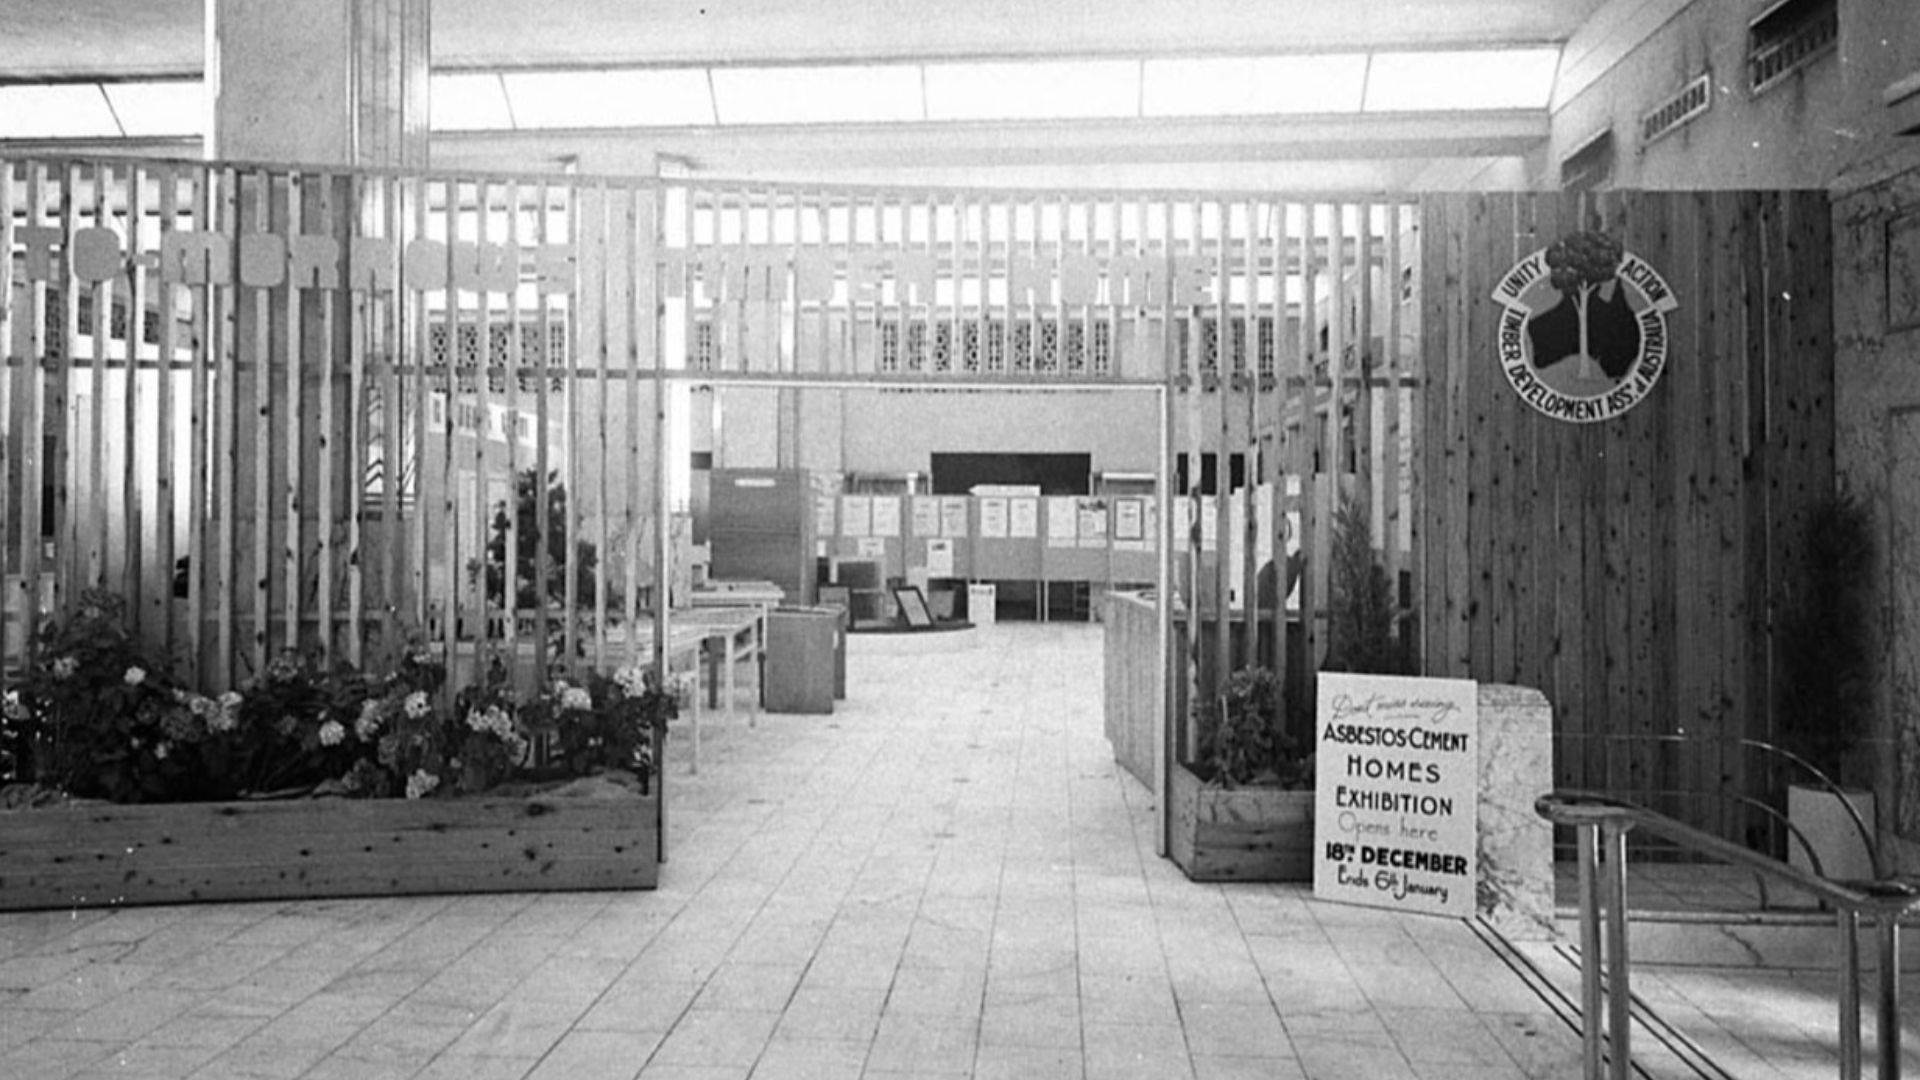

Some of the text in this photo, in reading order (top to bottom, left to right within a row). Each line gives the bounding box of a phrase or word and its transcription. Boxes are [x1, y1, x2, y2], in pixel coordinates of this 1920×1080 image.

[1501, 256, 1543, 298] UNITY
[1620, 258, 1671, 304] ACTION
[1503, 308, 1526, 361] TIMBER
[1636, 309, 1662, 383] AUSTRALIA
[1508, 364, 1604, 419] DEVELOPMENT
[1347, 754, 1441, 784] HOMES
[1336, 785, 1453, 816] EXHIBITION
[1338, 811, 1438, 842] Opens here
[1361, 845, 1468, 876] DECEMBER
[1338, 864, 1369, 888] Ends
[1393, 873, 1448, 904] January
